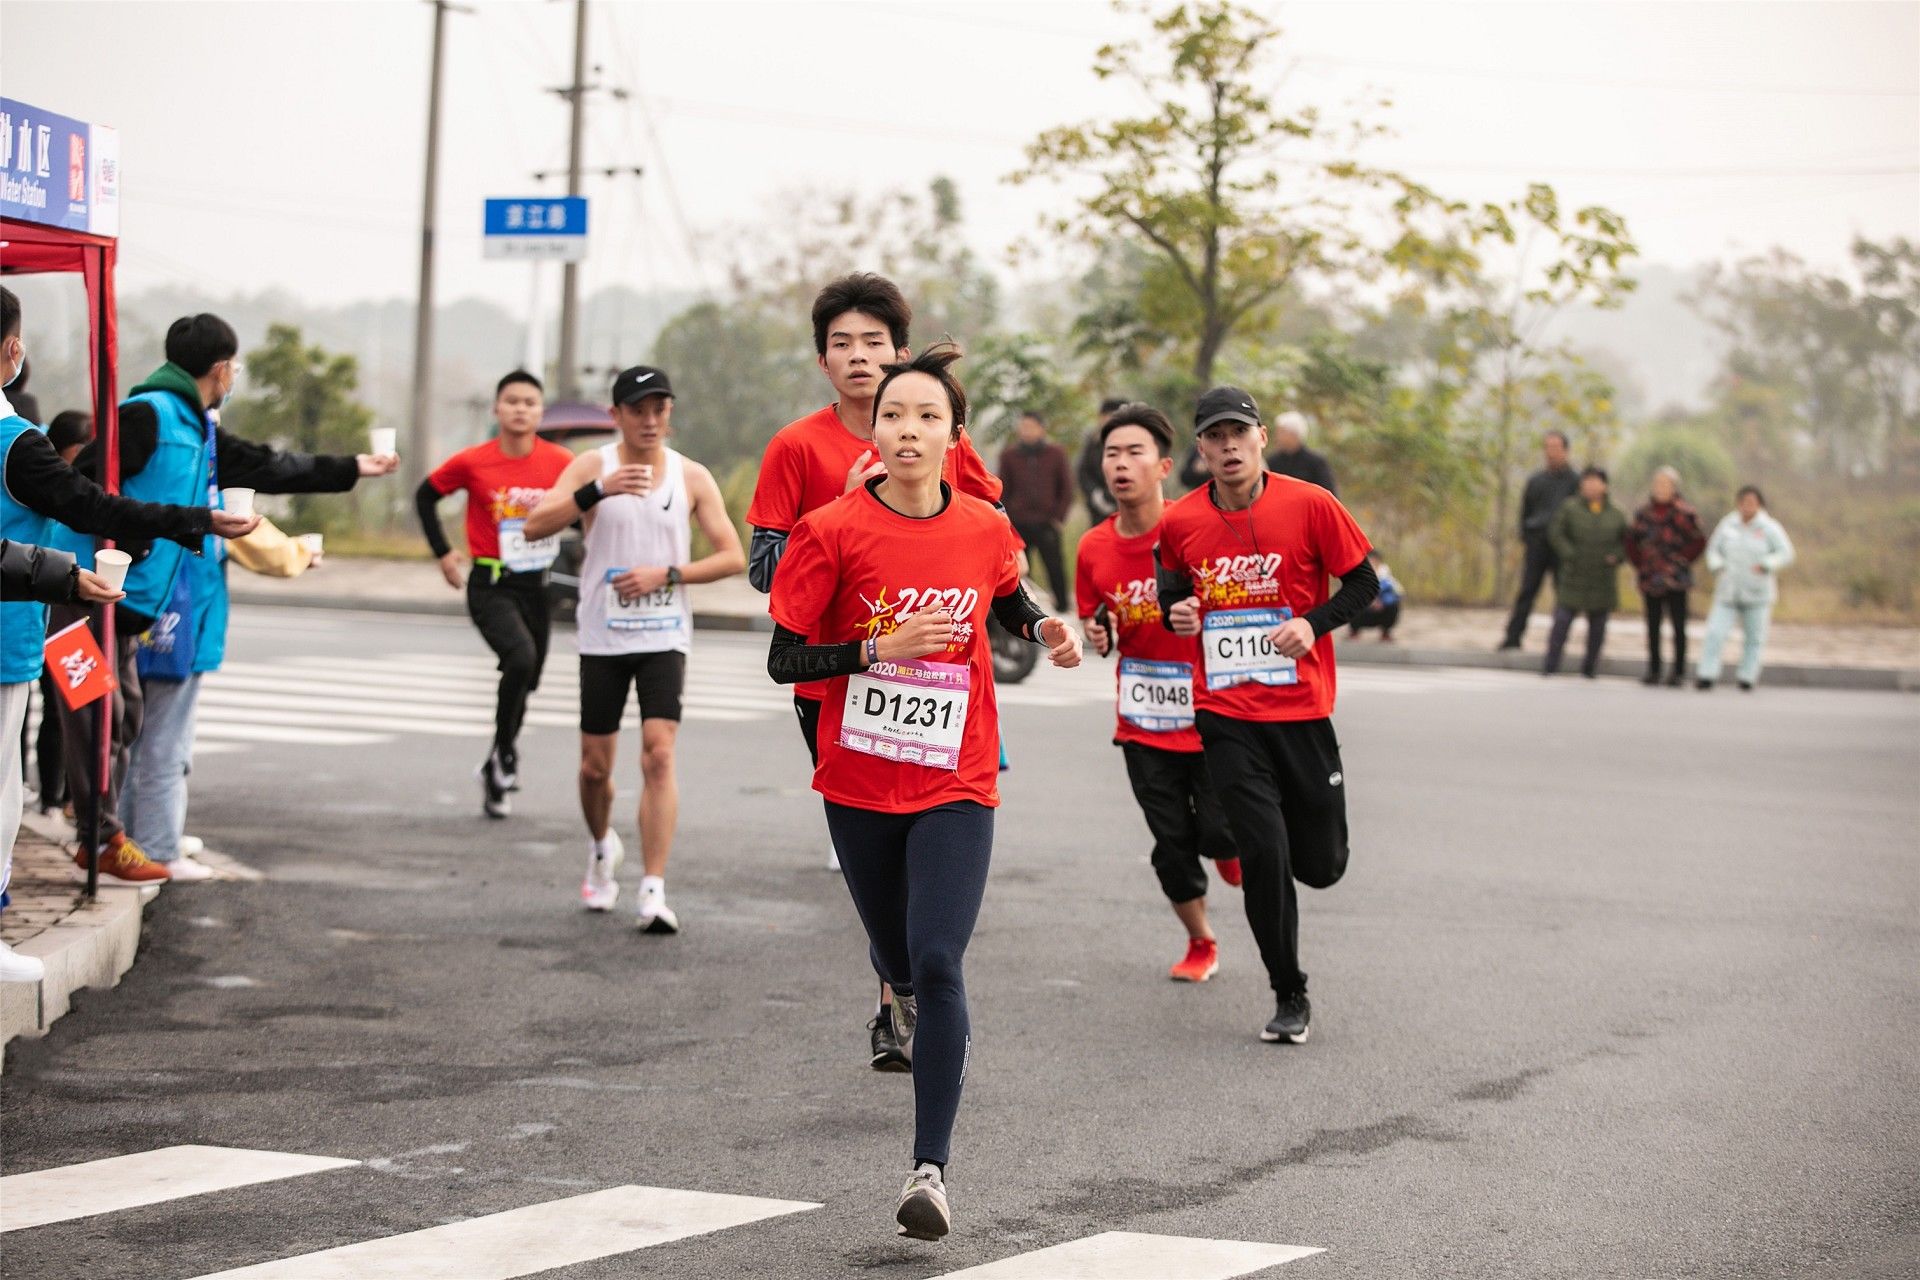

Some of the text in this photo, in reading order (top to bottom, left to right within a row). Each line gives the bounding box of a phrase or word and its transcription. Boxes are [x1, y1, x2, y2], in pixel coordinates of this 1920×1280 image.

[0, 171, 46, 208] Water Station
[1215, 552, 1283, 585] 2020
[894, 587, 978, 624] 2020
[864, 687, 953, 730] D1231
[1131, 683, 1189, 706] C1048
